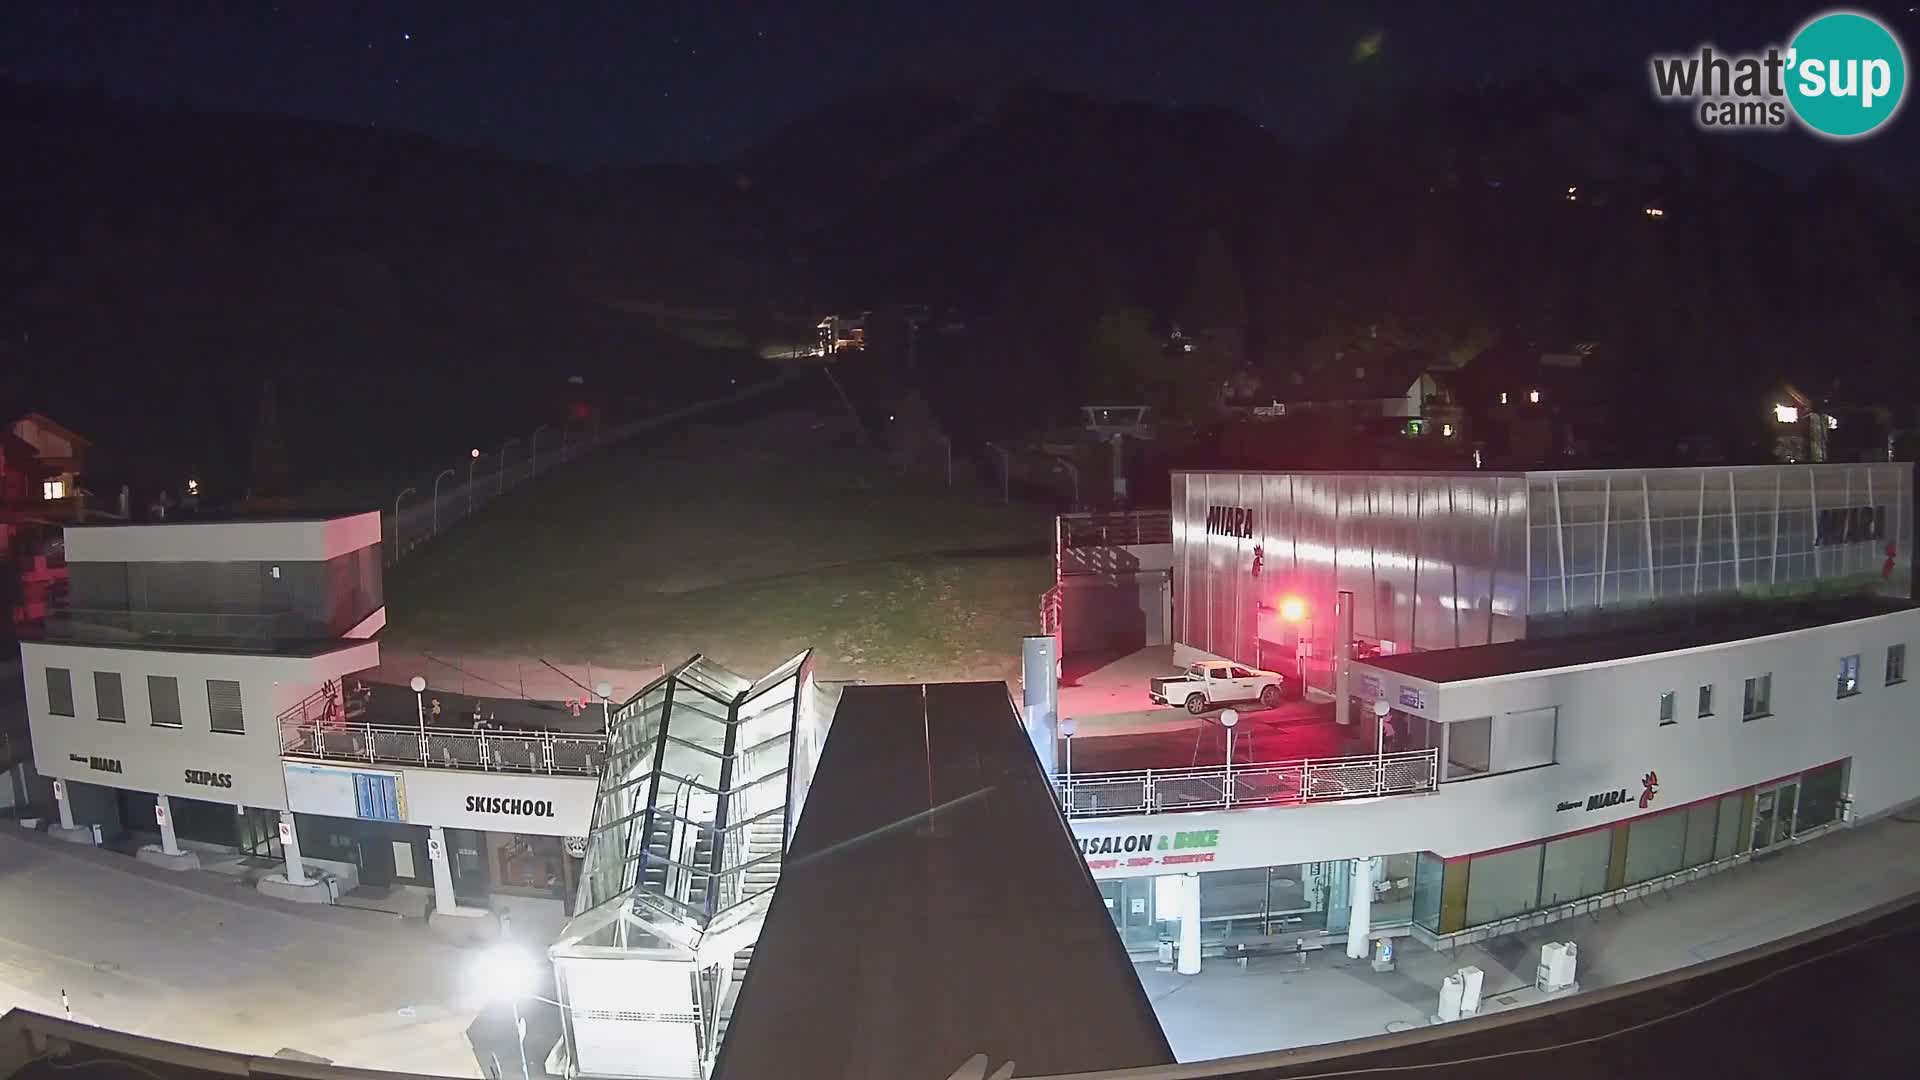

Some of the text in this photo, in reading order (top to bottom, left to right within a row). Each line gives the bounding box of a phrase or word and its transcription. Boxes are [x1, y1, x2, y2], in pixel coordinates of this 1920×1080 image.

[1206, 505, 1253, 539] MIARA
[185, 769, 232, 788] SKIPASS
[465, 796, 555, 817] SKISCHOOL
[1586, 789, 1626, 811] MIARA
